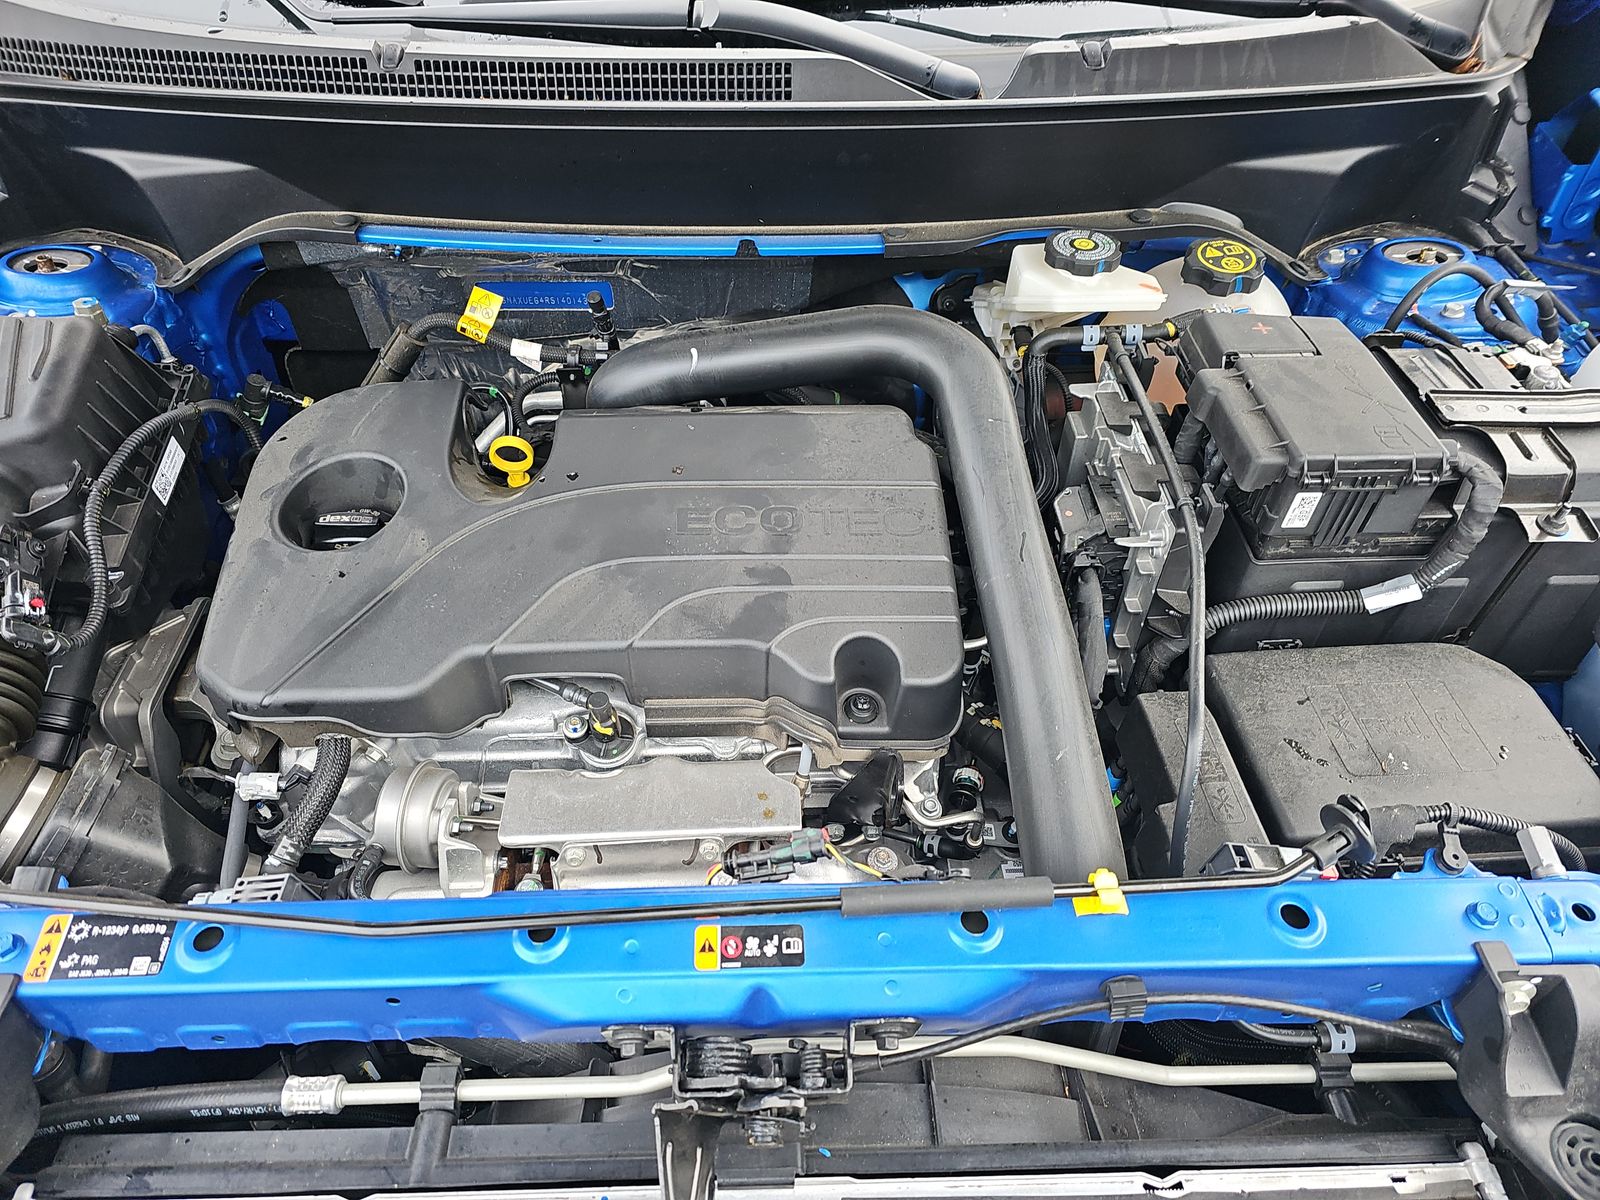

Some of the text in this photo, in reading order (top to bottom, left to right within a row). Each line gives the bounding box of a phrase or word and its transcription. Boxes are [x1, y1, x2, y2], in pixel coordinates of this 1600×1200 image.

[675, 505, 925, 536] ECOTEC
[744, 949, 761, 957] AUTO
[81, 954, 99, 966] PAG
